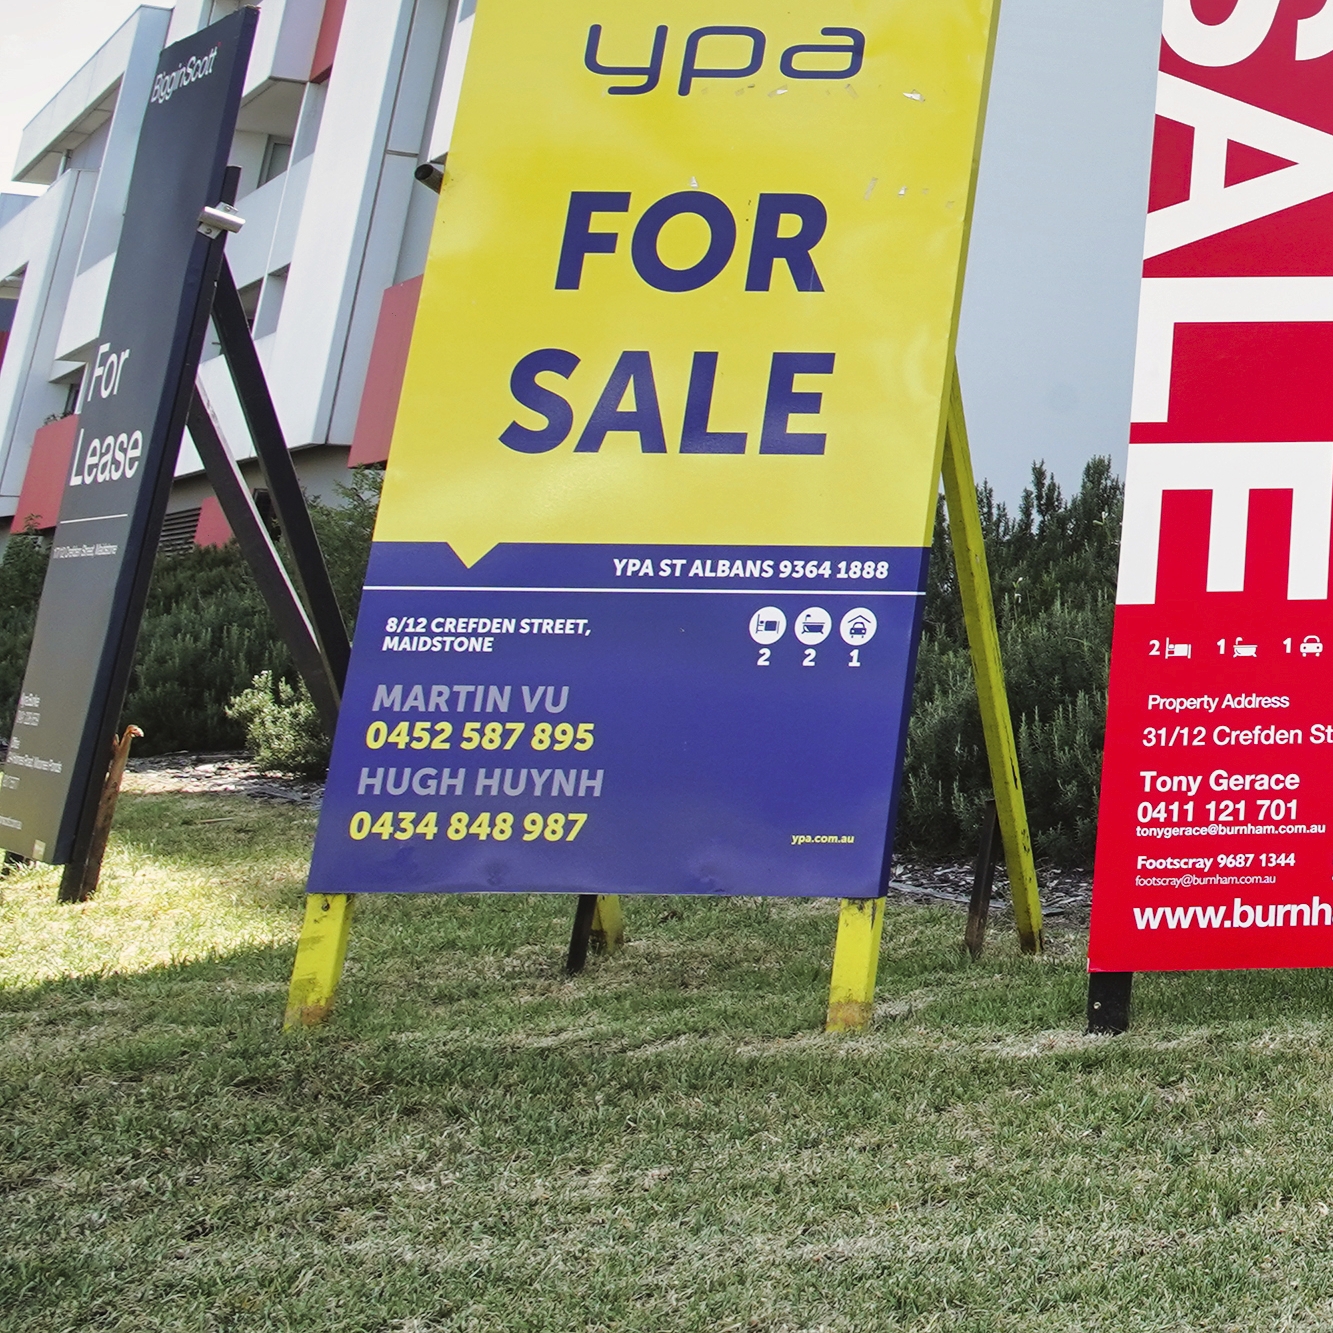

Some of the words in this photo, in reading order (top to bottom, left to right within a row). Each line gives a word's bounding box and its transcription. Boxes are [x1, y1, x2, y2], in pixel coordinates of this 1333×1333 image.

[584, 24, 865, 97] ypa
[554, 190, 827, 293] FOR
[87, 342, 130, 402] For
[498, 348, 836, 454] SALE
[69, 428, 143, 487] Lease
[613, 558, 654, 576] YPA
[658, 558, 687, 577] ST
[688, 559, 774, 578] ALBANS
[778, 560, 831, 578] 9364
[836, 560, 889, 579] 1888
[385, 616, 427, 633] 8/12
[430, 617, 516, 633] CREFDEN
[518, 618, 591, 636] STREET,
[381, 636, 494, 652] MAIDSTONE
[1149, 640, 1161, 657] 2
[1217, 639, 1226, 655] 1
[1283, 638, 1292, 654] 1
[757, 648, 771, 666] 2
[803, 648, 816, 666] 2
[848, 649, 861, 667] 1
[371, 684, 512, 712] MARTIN
[521, 685, 569, 713] VU
[1147, 694, 1219, 713] Property
[1221, 693, 1290, 709] Address
[365, 720, 453, 750] 0452
[459, 721, 525, 750] 587
[530, 722, 594, 751] 895
[1142, 726, 1206, 747] 31/12
[1212, 724, 1302, 746] Crefden
[357, 767, 466, 796] HUGH
[474, 768, 604, 797] HUYNH
[1139, 770, 1202, 796] Tony
[1208, 769, 1300, 791] Gerace
[1137, 800, 1194, 823] 0411
[1205, 799, 1245, 821] 121
[1256, 798, 1297, 820] 701
[349, 811, 438, 840] 0434
[446, 811, 514, 841] 848
[522, 812, 588, 841] 987
[1135, 823, 1326, 838] tonygerace@burnham.com.au
[790, 835, 854, 845] ypa.com.au
[1136, 855, 1214, 872] Footscray
[1216, 853, 1255, 868] 9687
[1259, 852, 1296, 867] 1344
[1135, 873, 1276, 888] footscray@burnham.com.au
